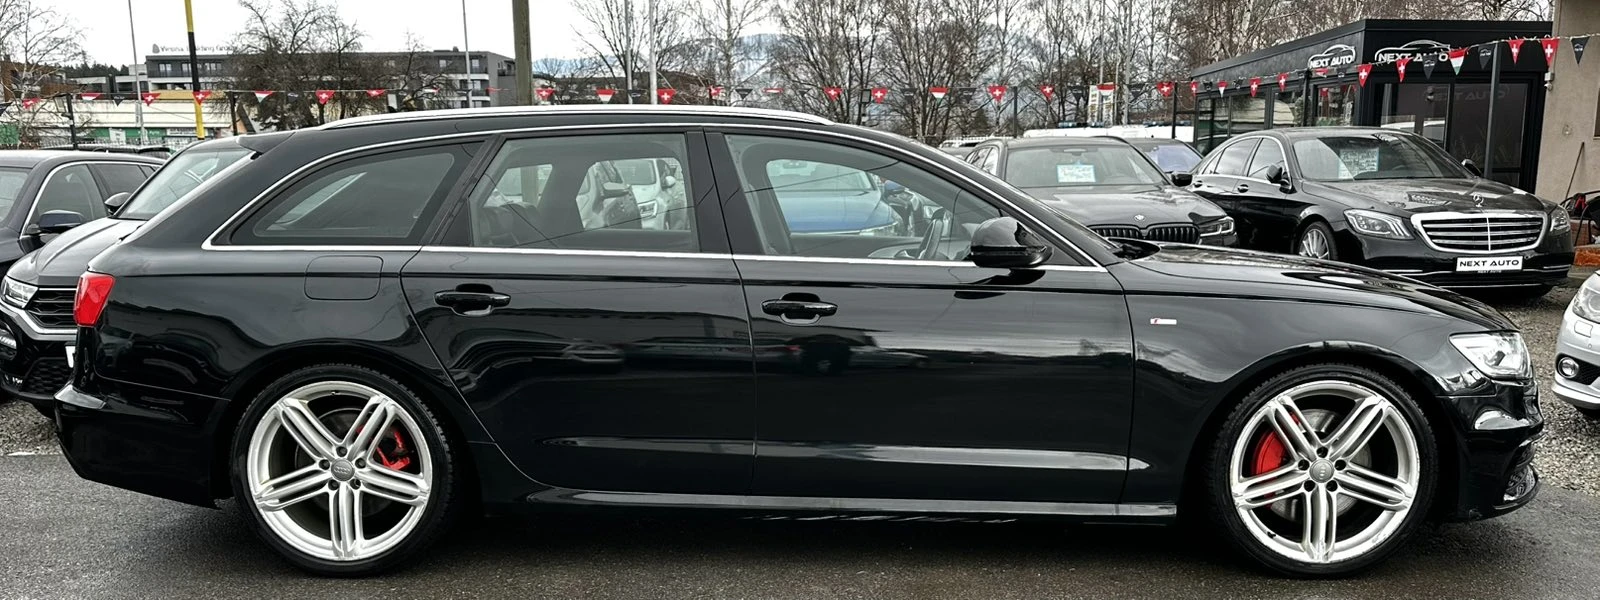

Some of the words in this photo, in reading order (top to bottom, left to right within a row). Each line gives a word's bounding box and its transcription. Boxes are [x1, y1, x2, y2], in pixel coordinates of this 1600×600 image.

[1309, 58, 1330, 69] NEXT
[1330, 55, 1353, 66] AUTO
[1413, 53, 1449, 62] AO
